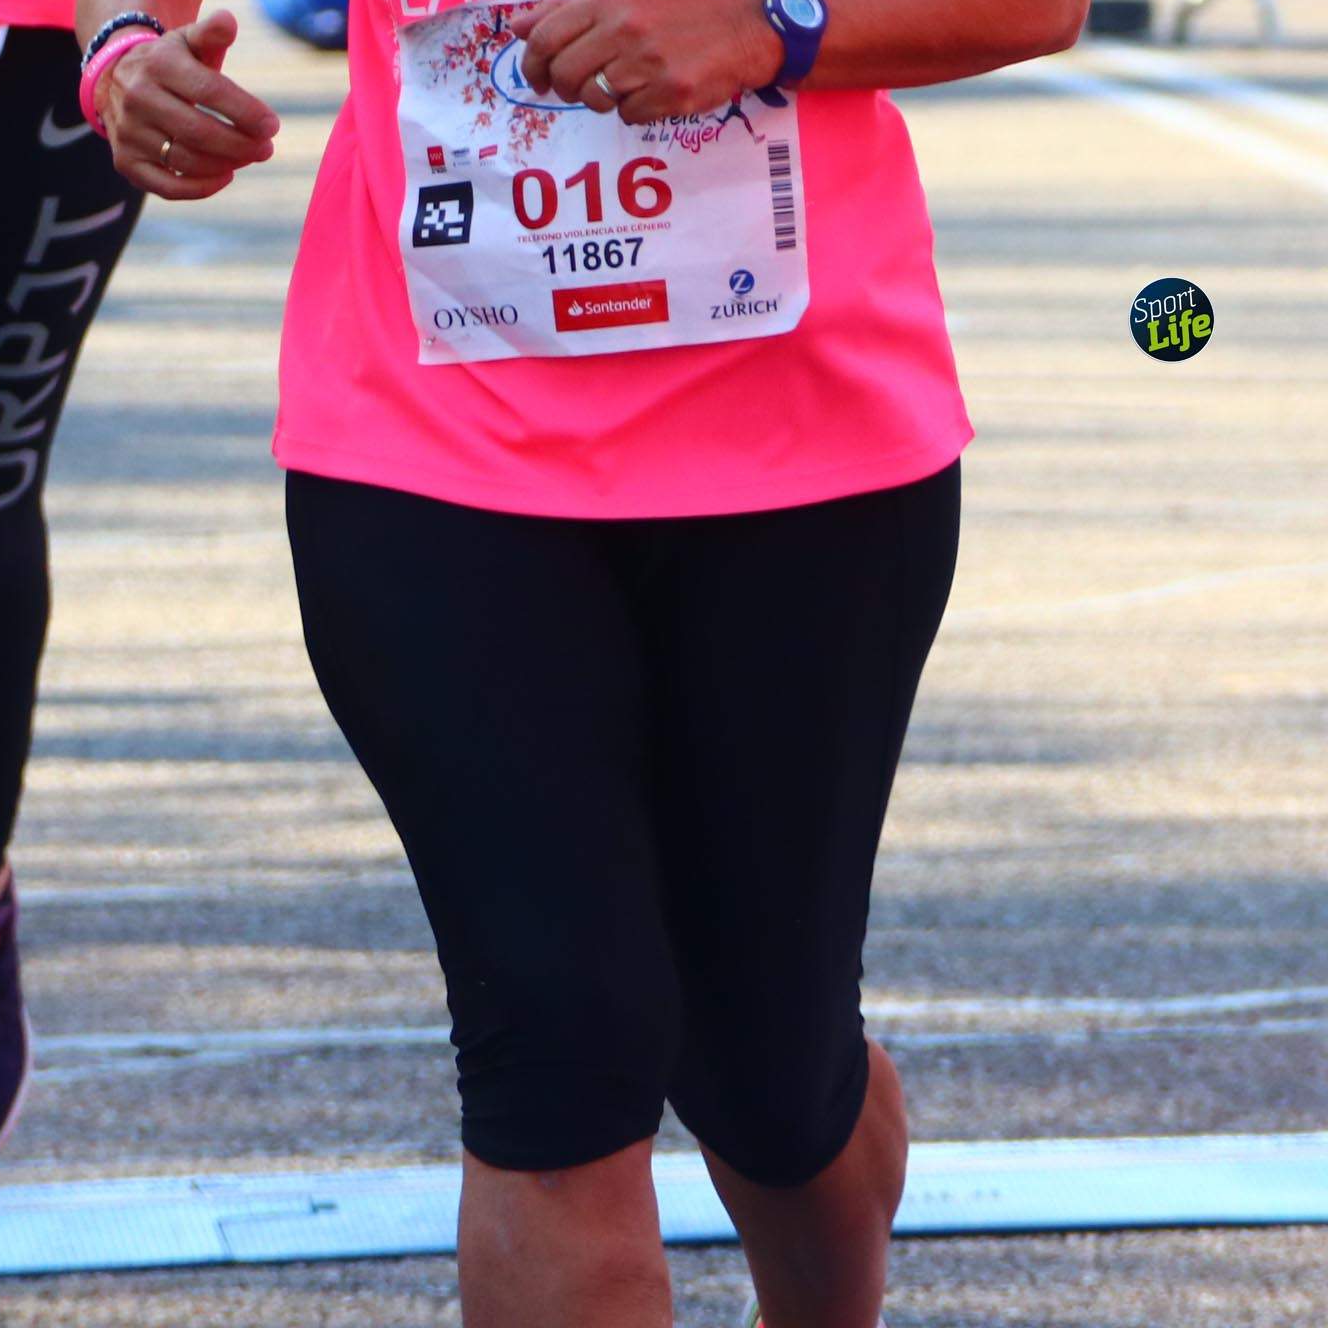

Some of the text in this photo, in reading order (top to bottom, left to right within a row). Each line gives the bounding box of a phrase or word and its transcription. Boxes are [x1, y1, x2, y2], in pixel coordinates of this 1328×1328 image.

[642, 123, 722, 153] de la Mujer
[512, 156, 672, 229] 016
[564, 227, 614, 239] VIOLENCIA
[617, 225, 628, 233] DE
[631, 221, 671, 233] GÉNERO
[542, 237, 643, 274] 11867
[434, 304, 518, 330] OYSHO
[586, 296, 653, 315] Santander
[711, 299, 778, 320] ZURICH
